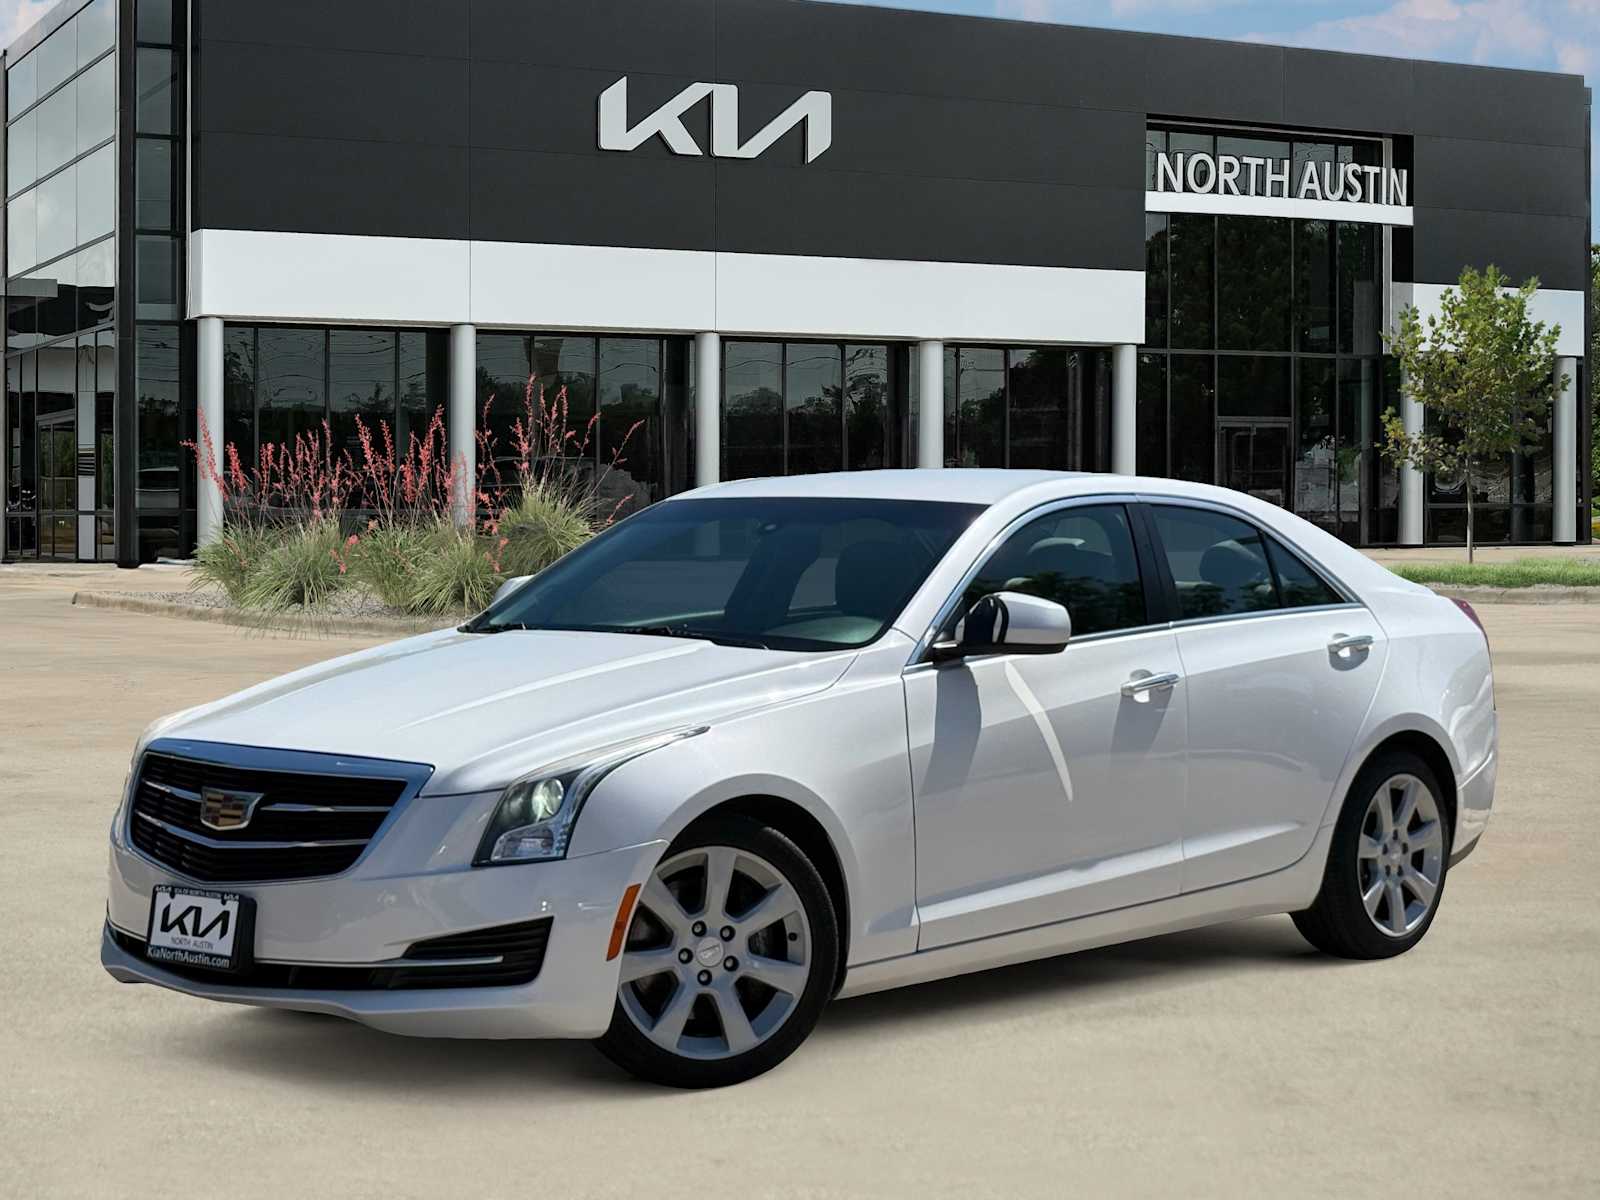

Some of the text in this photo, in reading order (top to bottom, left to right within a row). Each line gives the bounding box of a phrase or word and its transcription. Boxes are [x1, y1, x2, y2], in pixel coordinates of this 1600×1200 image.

[599, 75, 832, 164] KIA
[1157, 151, 1408, 206] NORTH AUSTIN
[160, 902, 230, 940] KIA
[146, 946, 230, 969] KiaNorthAustin.com
[171, 937, 214, 950] NORTH AUSTIN
